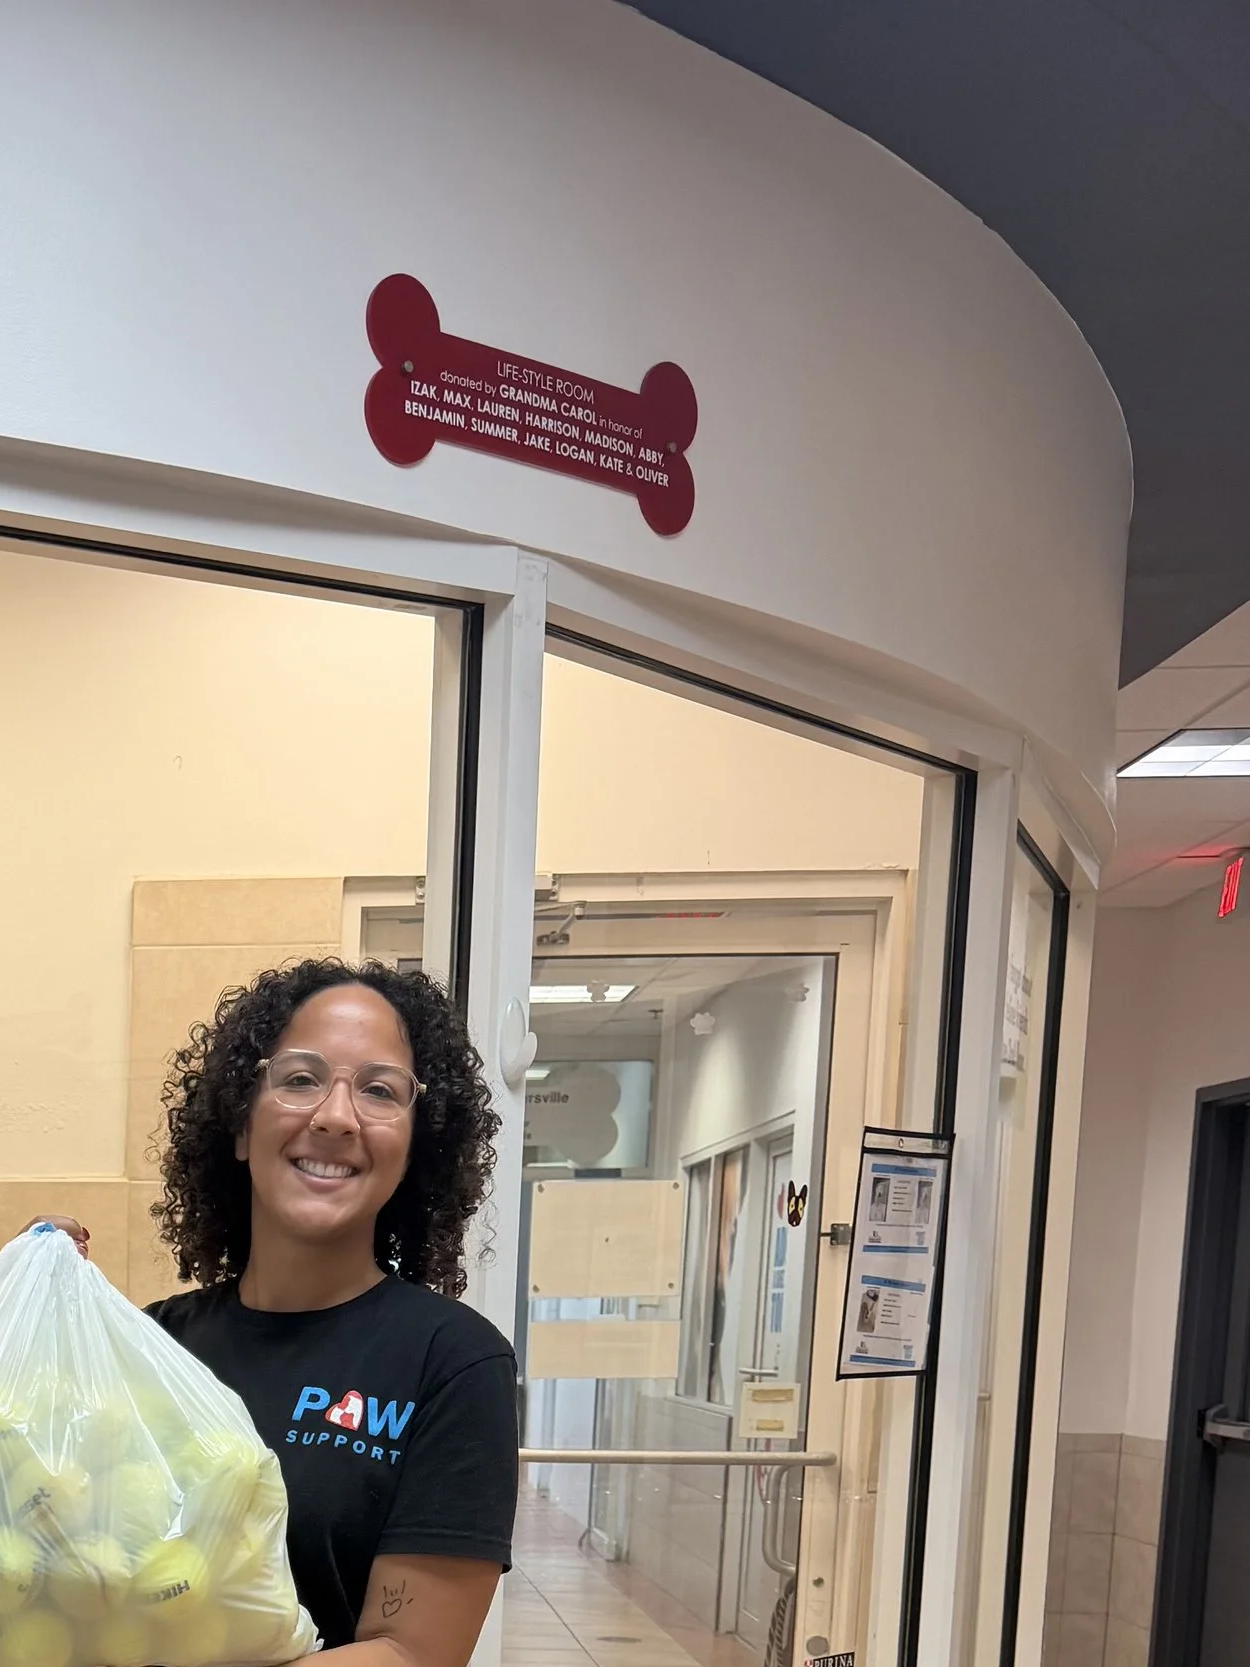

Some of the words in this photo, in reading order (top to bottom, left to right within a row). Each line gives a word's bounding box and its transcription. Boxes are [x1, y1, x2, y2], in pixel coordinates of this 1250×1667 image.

[440, 370, 482, 391] donated
[485, 381, 497, 397] by
[499, 384, 558, 413] GRANDMA
[561, 402, 597, 425] CAROL
[599, 416, 607, 427] in
[609, 419, 632, 436] honor
[634, 428, 643, 439] of
[497, 361, 553, 392] LIFE-STYLE
[556, 379, 594, 404] ROOM
[404, 400, 468, 430] BENJAMIN,
[471, 418, 521, 444] SUMMER,
[524, 432, 553, 453] JAKE,
[556, 441, 597, 466] LOGAN,
[600, 454, 624, 473] KATE
[626, 463, 633, 475] &
[636, 466, 669, 487] OLIVER
[411, 380, 440, 401] IZAK,
[443, 389, 474, 411] MAX,
[477, 399, 522, 424] LAUREN,
[526, 412, 582, 441] HARRISON,
[585, 430, 636, 458] MADISON,
[638, 447, 665, 467] ABBY,
[286, 1429, 401, 1465] SUPPORT
